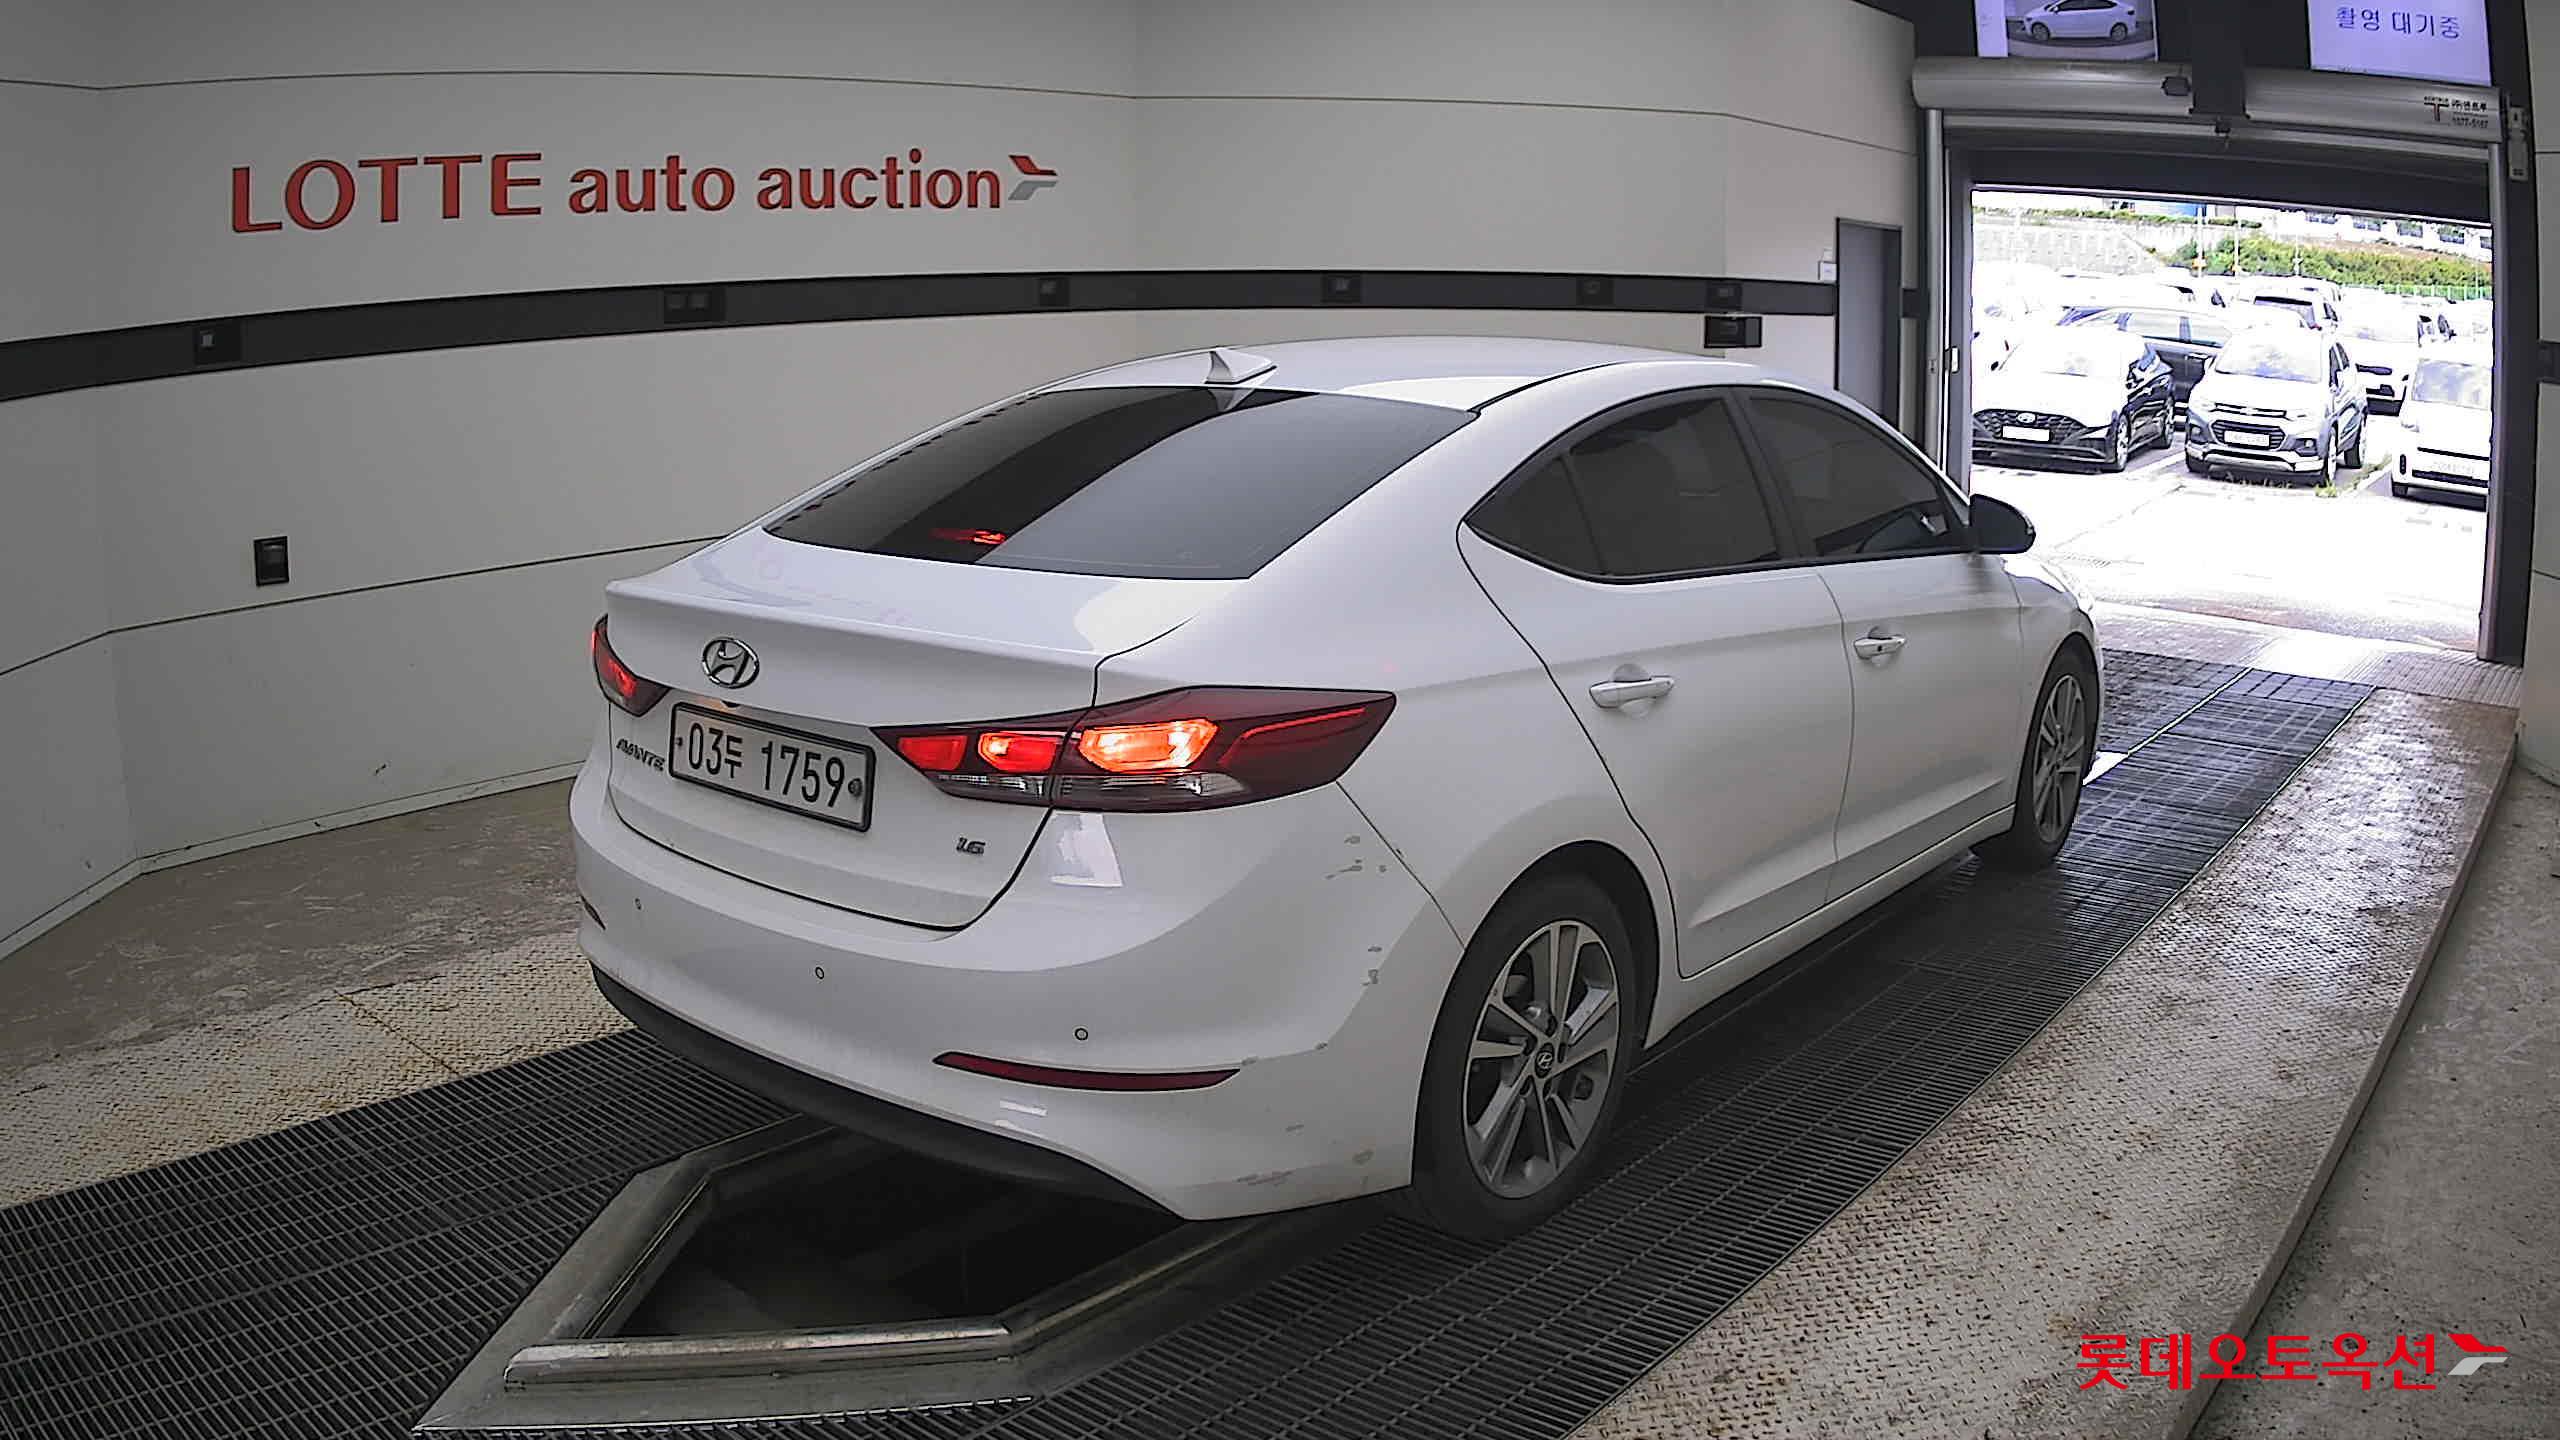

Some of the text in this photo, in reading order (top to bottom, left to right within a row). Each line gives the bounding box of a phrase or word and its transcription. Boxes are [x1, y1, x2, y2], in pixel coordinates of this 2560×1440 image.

[2337, 6, 2459, 39] 촬영 대기중
[232, 148, 1002, 232] LOTTE auto auction
[615, 738, 665, 772] AVANTE
[688, 722, 845, 808] 03두 1759
